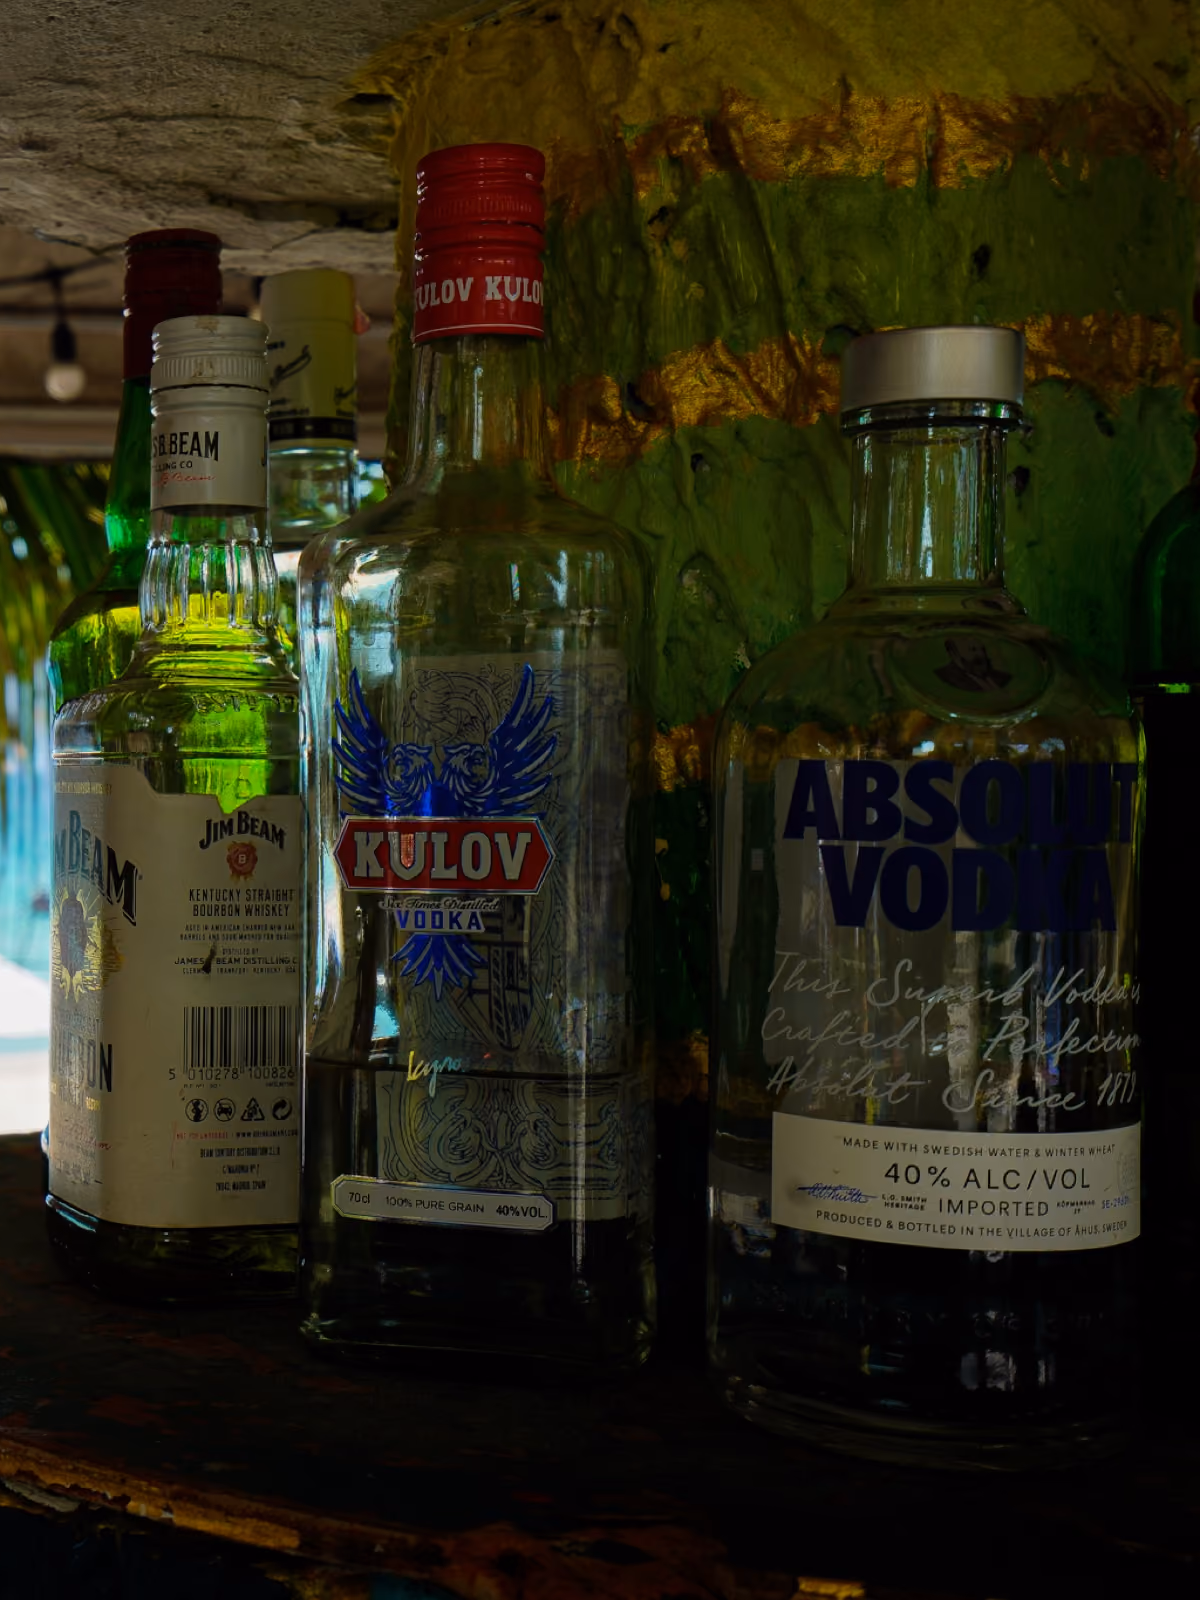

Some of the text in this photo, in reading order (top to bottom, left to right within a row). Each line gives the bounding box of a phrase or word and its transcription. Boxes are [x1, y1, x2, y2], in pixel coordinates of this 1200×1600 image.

[169, 431, 219, 462] BEAM
[180, 460, 193, 469] CO
[783, 759, 1138, 845] ABSOLUT
[199, 810, 285, 850] JIM BEAM
[353, 831, 532, 882] KULOV
[68, 810, 138, 927] BEAM
[189, 888, 296, 902] KENTUCKY STRAIGHT
[820, 845, 1117, 933] VODKA
[193, 904, 290, 917] BOURBON WHISKEY
[397, 910, 481, 930] VODKA
[175, 957, 205, 965] JAMES
[216, 957, 240, 965] BEAM
[243, 957, 290, 965] DISTILLING
[768, 950, 851, 999] This
[866, 957, 1035, 1056] Superb
[1044, 965, 1129, 1007] Vodka
[761, 1007, 921, 1056] Crafted
[169, 1068, 176, 1080] 5
[765, 1055, 932, 1105] Absolut
[941, 1068, 1087, 1114] Since
[843, 1137, 1116, 1157] MADE WITH SWEDISH WATER & WINTER WHEAT
[885, 1163, 1090, 1190] 40% ALC/VOL
[349, 1192, 371, 1205] 70cl
[415, 1200, 445, 1211] PURE
[448, 1201, 485, 1213] GRAIN
[884, 1201, 926, 1211] HERITAGE
[939, 1200, 1049, 1216] IMPORTED
[816, 1210, 883, 1229] PRODUCED
[886, 1220, 894, 1230] &
[898, 1221, 956, 1236] BOTTLED
[960, 1226, 975, 1236] IN
[979, 1226, 1003, 1237] THE
[1006, 1226, 1055, 1239] VILLAGE
[1058, 1227, 1072, 1237] OF
